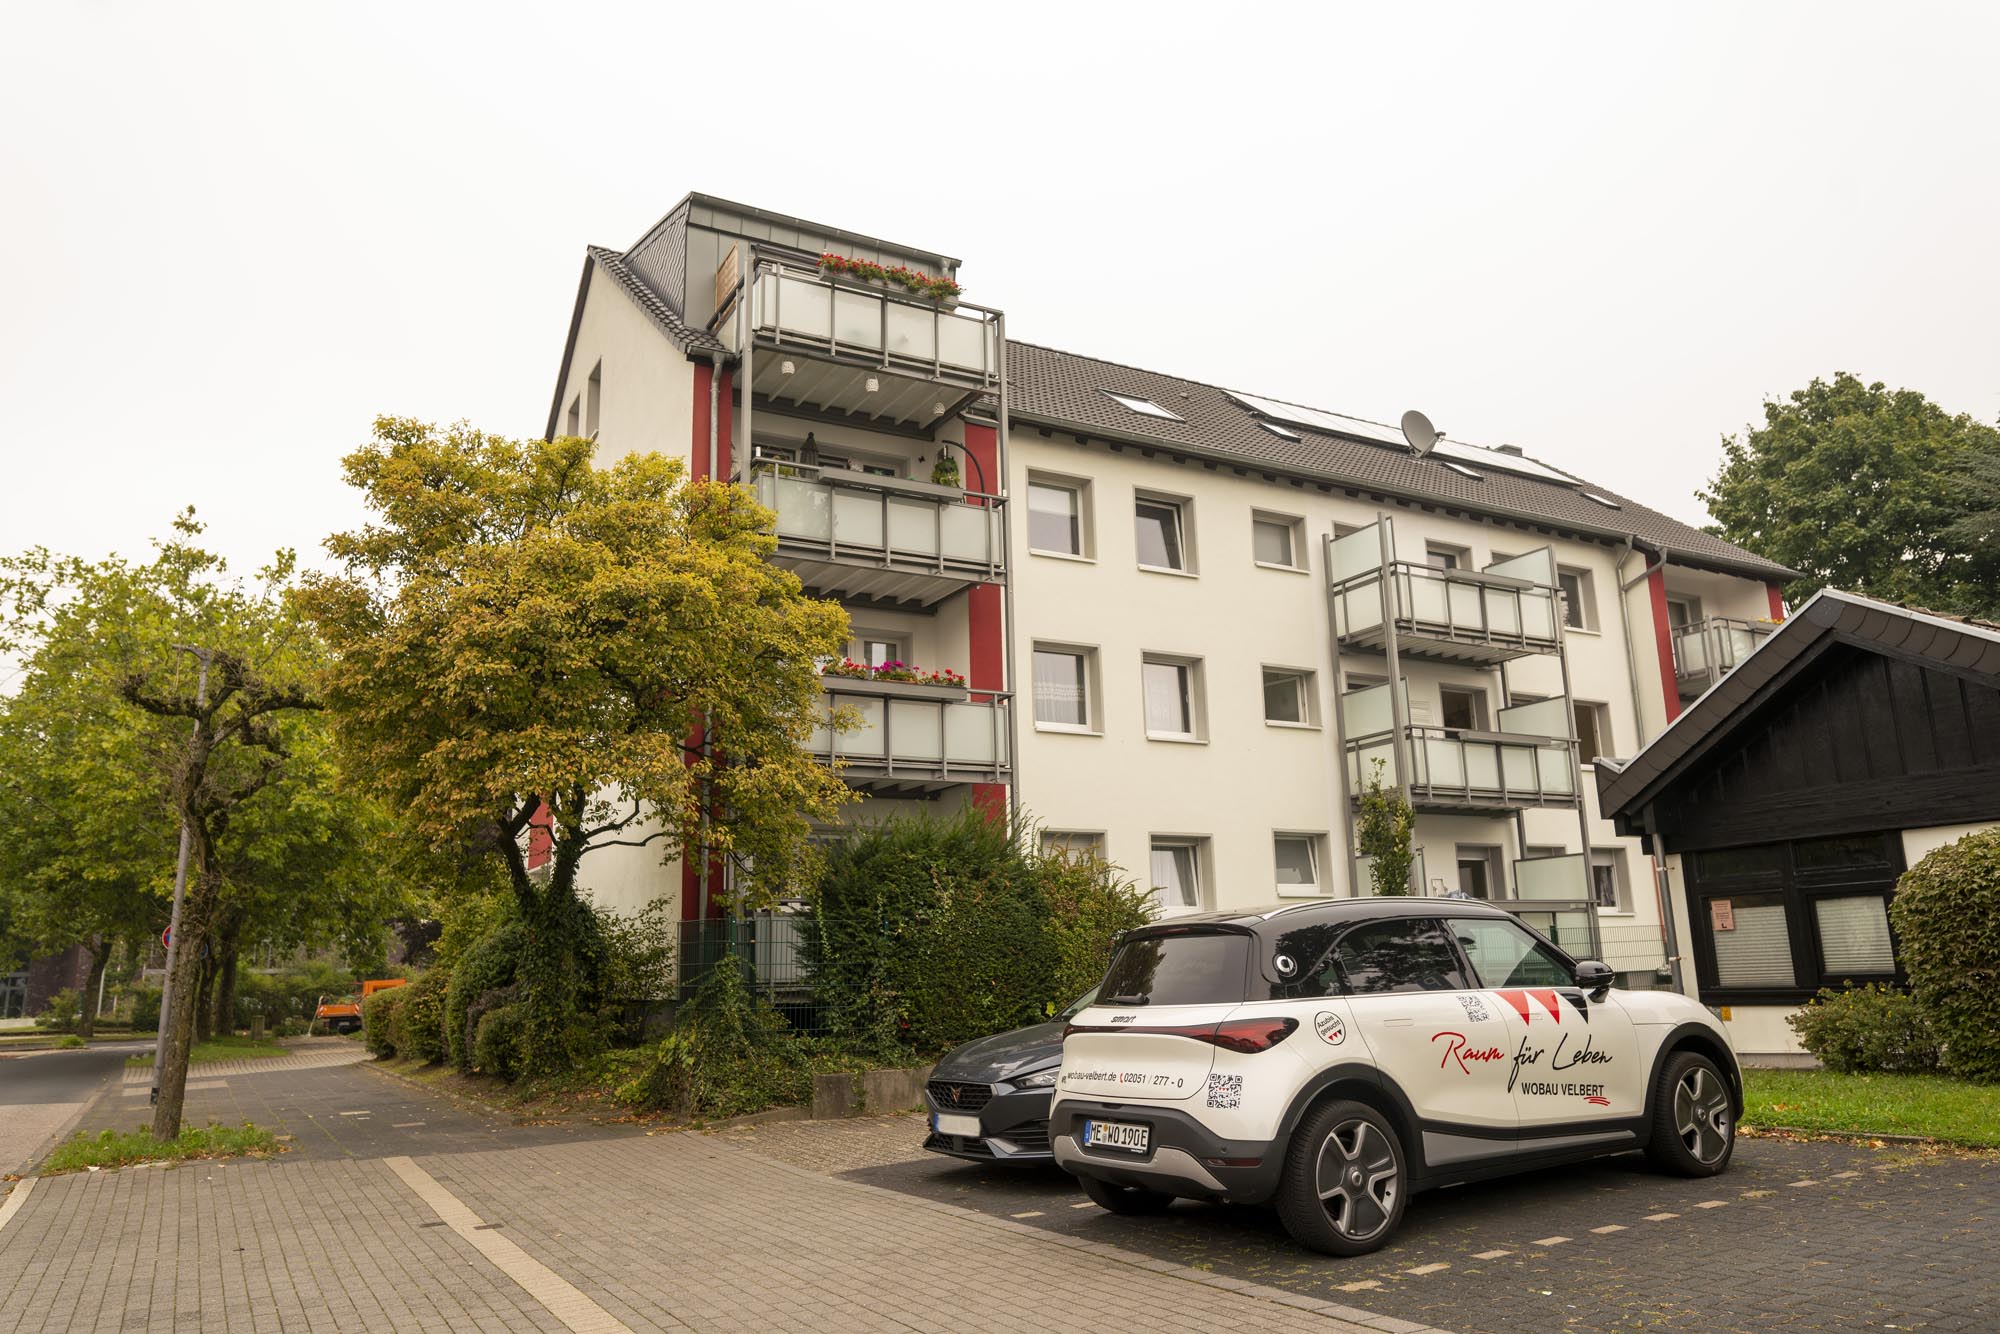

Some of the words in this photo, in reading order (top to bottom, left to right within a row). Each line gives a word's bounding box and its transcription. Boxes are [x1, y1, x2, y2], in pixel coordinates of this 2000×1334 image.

[1110, 1015, 1137, 1023] smart
[1317, 1015, 1335, 1028] Azubis
[1320, 1020, 1341, 1037] gesucht
[1431, 1031, 1505, 1075] Raum
[1507, 1035, 1545, 1093] für
[1552, 1032, 1613, 1071] Leben
[1067, 1071, 1117, 1082] wobau-velbert.de
[1123, 1072, 1146, 1084] 02051
[1153, 1075, 1169, 1086] 277
[1177, 1078, 1183, 1088] 0
[1521, 1082, 1558, 1096] WOBAU
[1561, 1083, 1604, 1097] VELBERT
[1090, 1123, 1102, 1141] ME
[1108, 1125, 1120, 1143] WO
[1121, 1127, 1148, 1148] 190E
